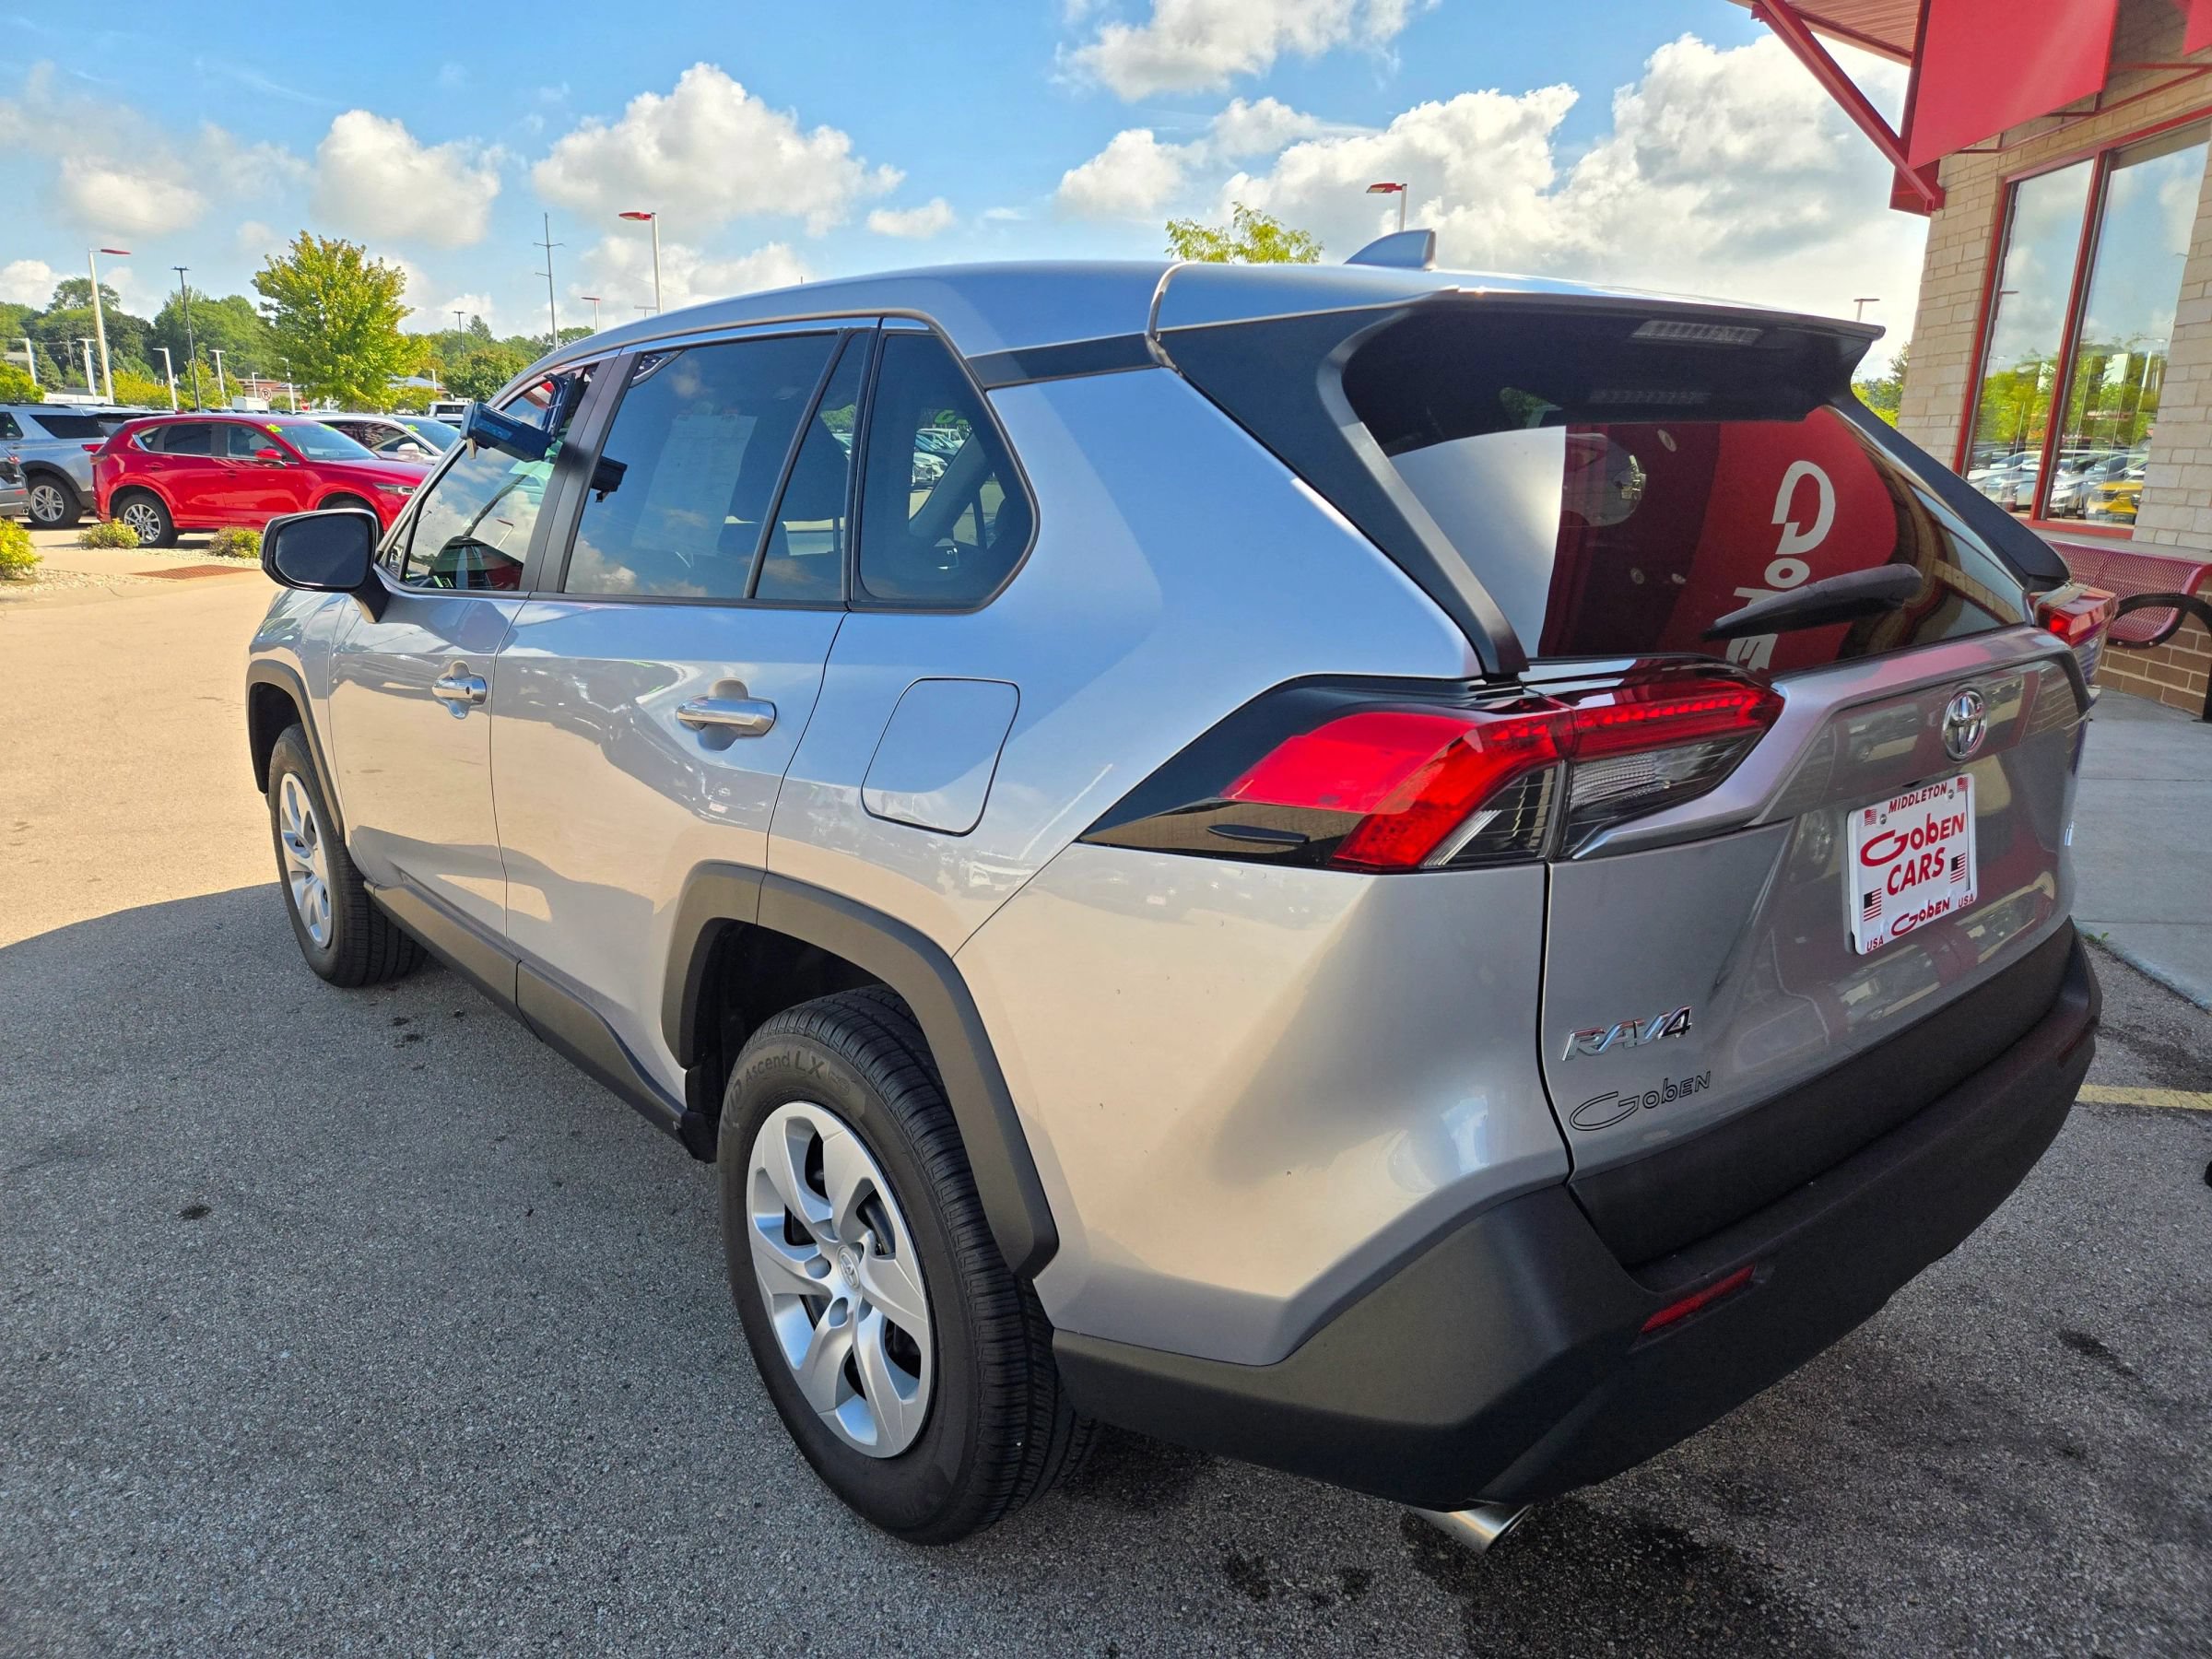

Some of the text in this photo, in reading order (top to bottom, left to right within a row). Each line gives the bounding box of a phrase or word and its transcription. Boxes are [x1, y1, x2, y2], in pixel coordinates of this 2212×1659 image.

[1888, 782, 1947, 814] MIDDLETON
[1887, 847, 1946, 896] CARS
[1866, 935, 1884, 952] USA
[1958, 893, 1974, 908] USA
[1562, 1005, 1693, 1061] RAV4
[745, 1050, 825, 1082] Ascend LX
